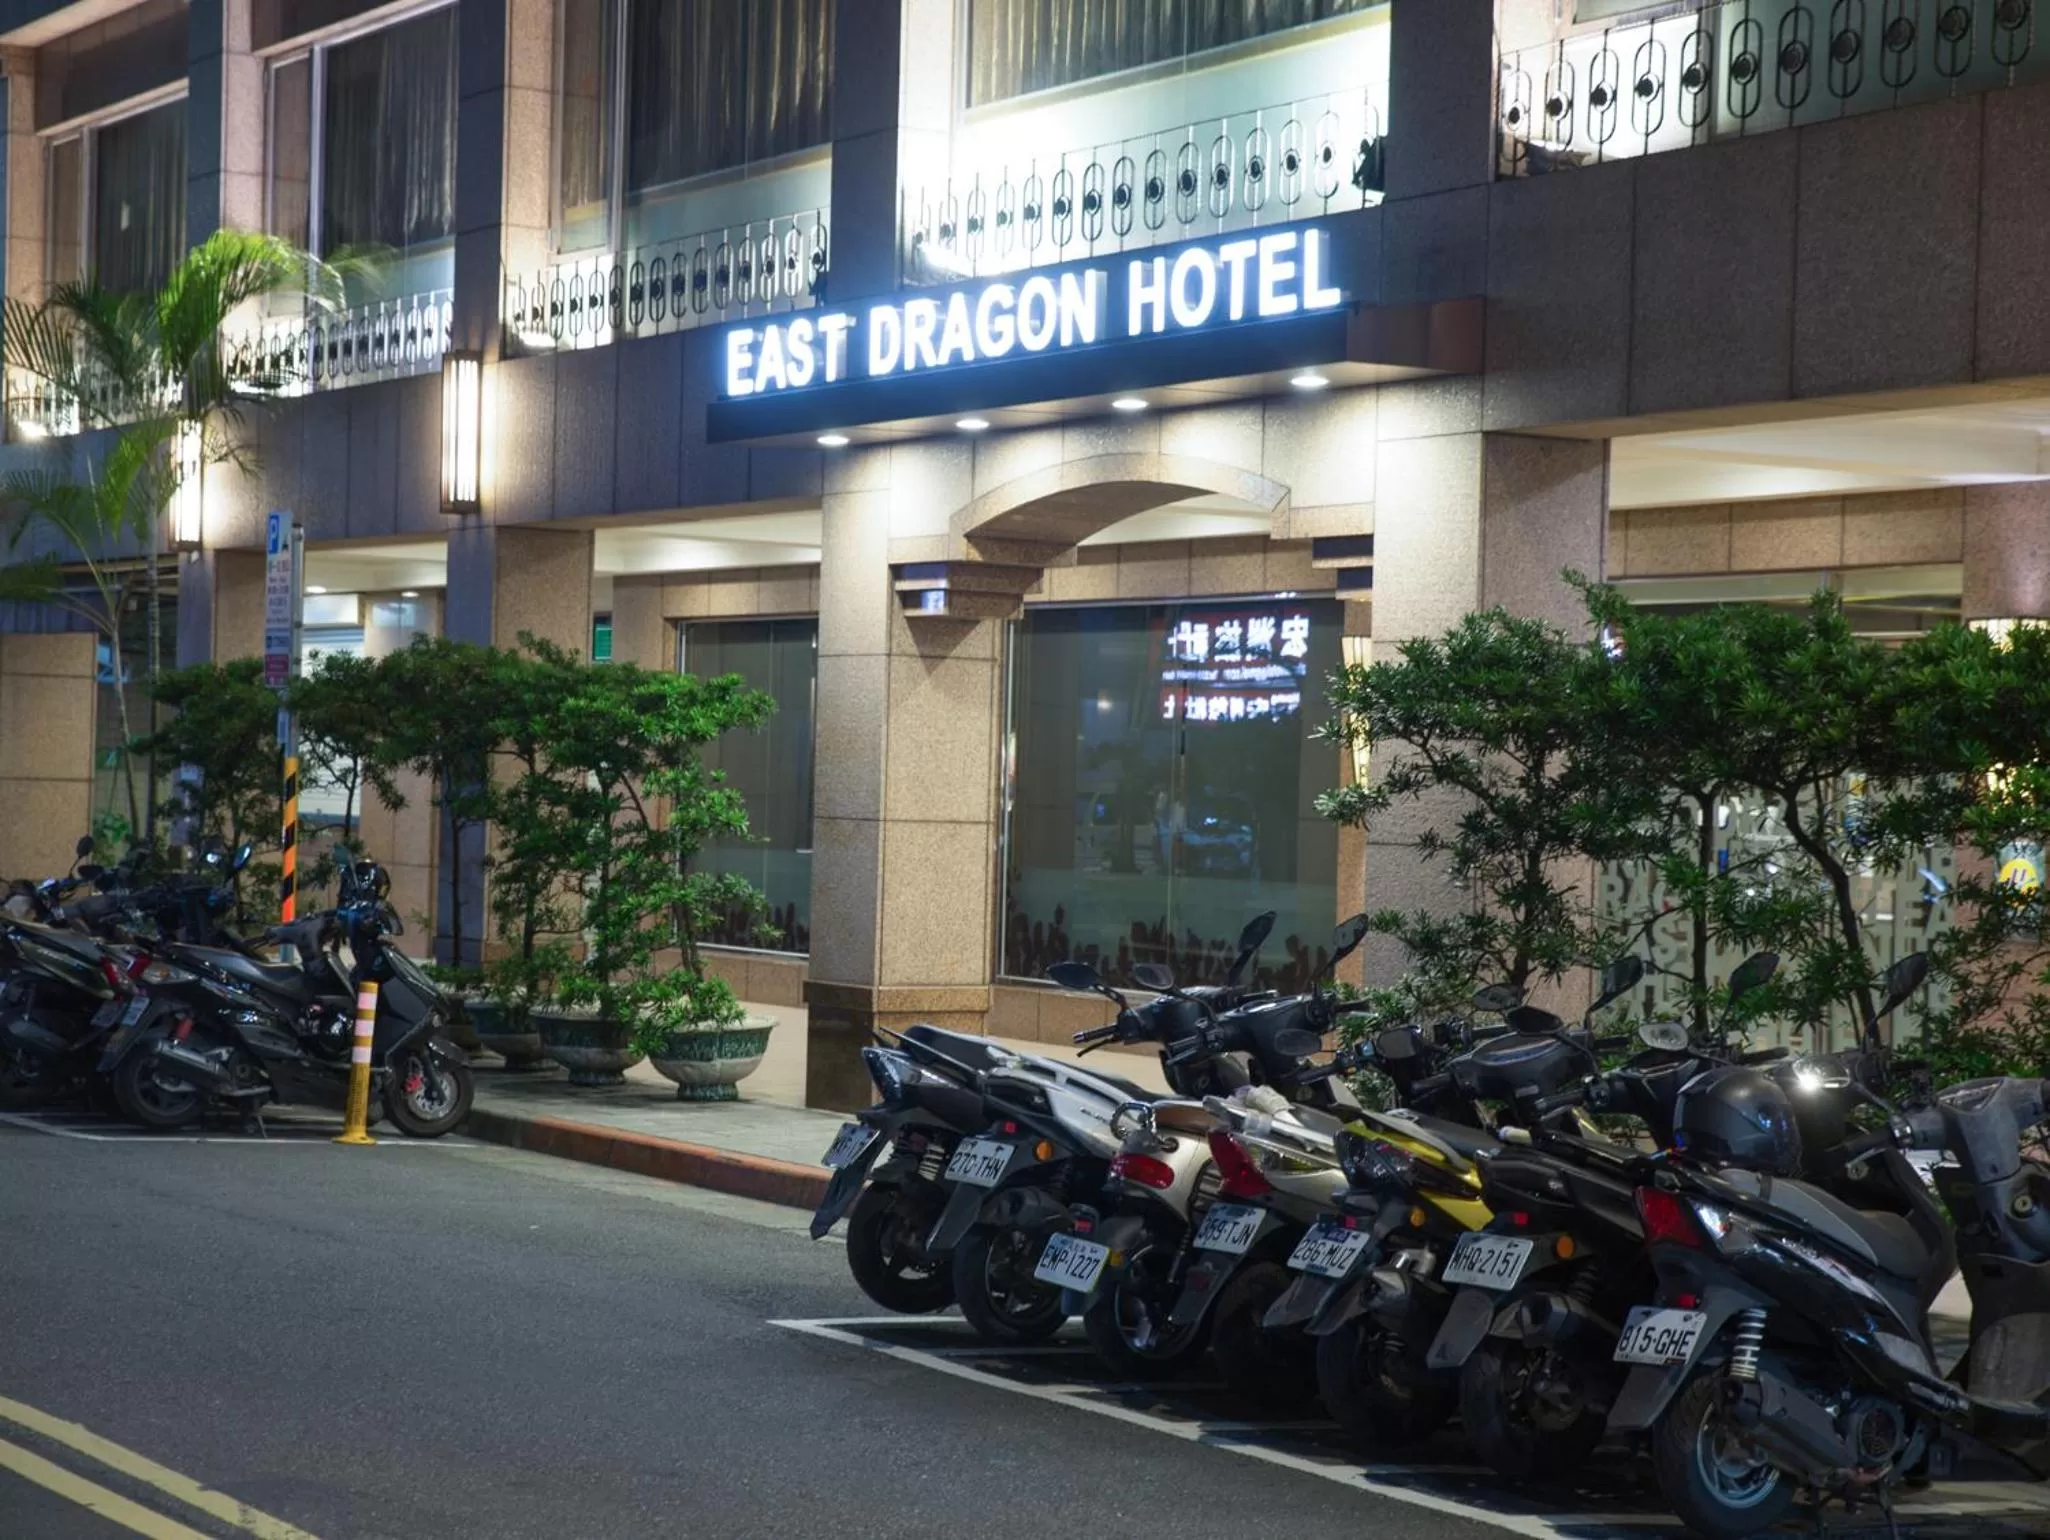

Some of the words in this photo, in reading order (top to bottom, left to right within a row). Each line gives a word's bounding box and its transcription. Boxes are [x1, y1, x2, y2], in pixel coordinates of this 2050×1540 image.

[727, 313, 847, 396] EAST
[867, 268, 1098, 377] DRAGON
[1128, 228, 1341, 336] HOTEL
[1039, 1245, 1101, 1280] EMP-1227
[1619, 1326, 1696, 1357] 815-GHE
